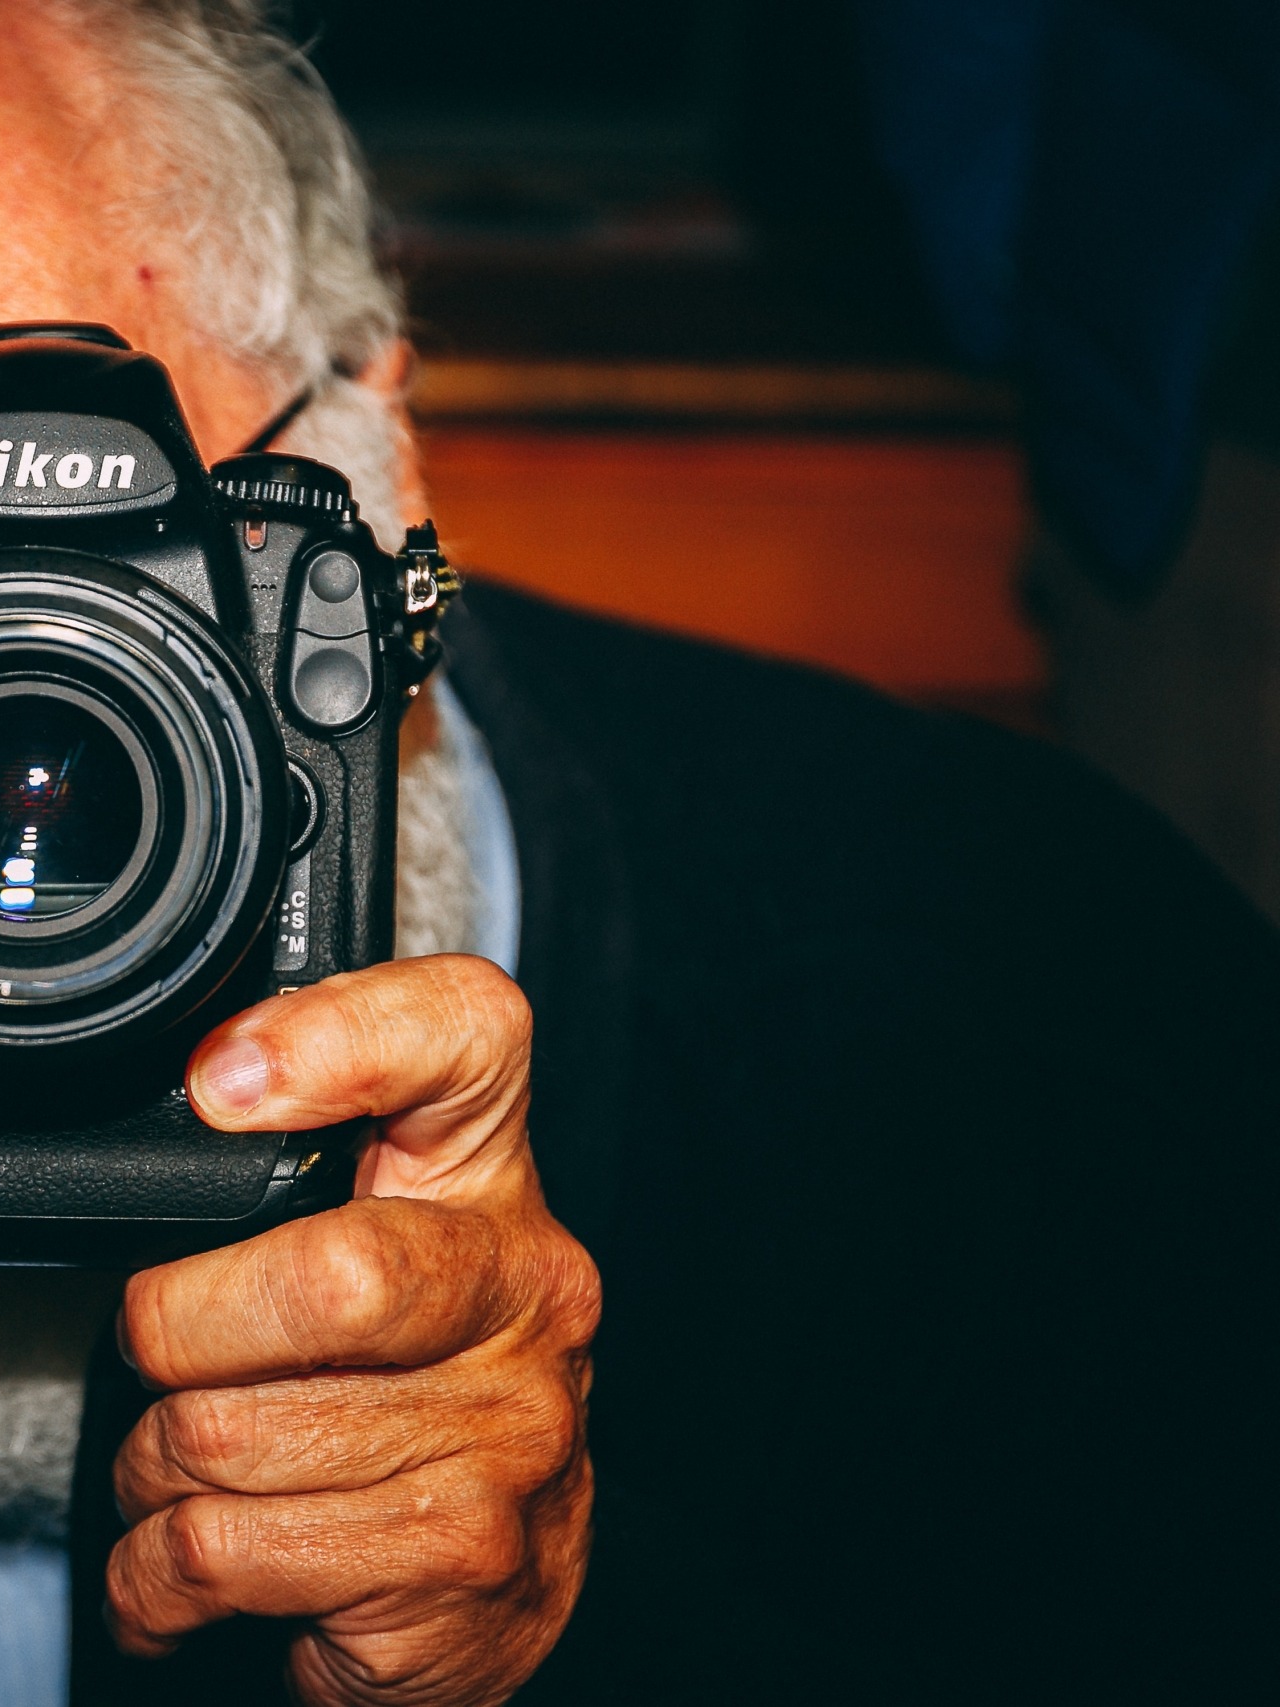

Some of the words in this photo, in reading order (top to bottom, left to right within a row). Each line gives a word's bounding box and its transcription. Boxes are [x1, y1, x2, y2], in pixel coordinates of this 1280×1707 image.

[291, 890, 306, 908] C
[291, 911, 306, 929] S
[288, 936, 305, 954] M
